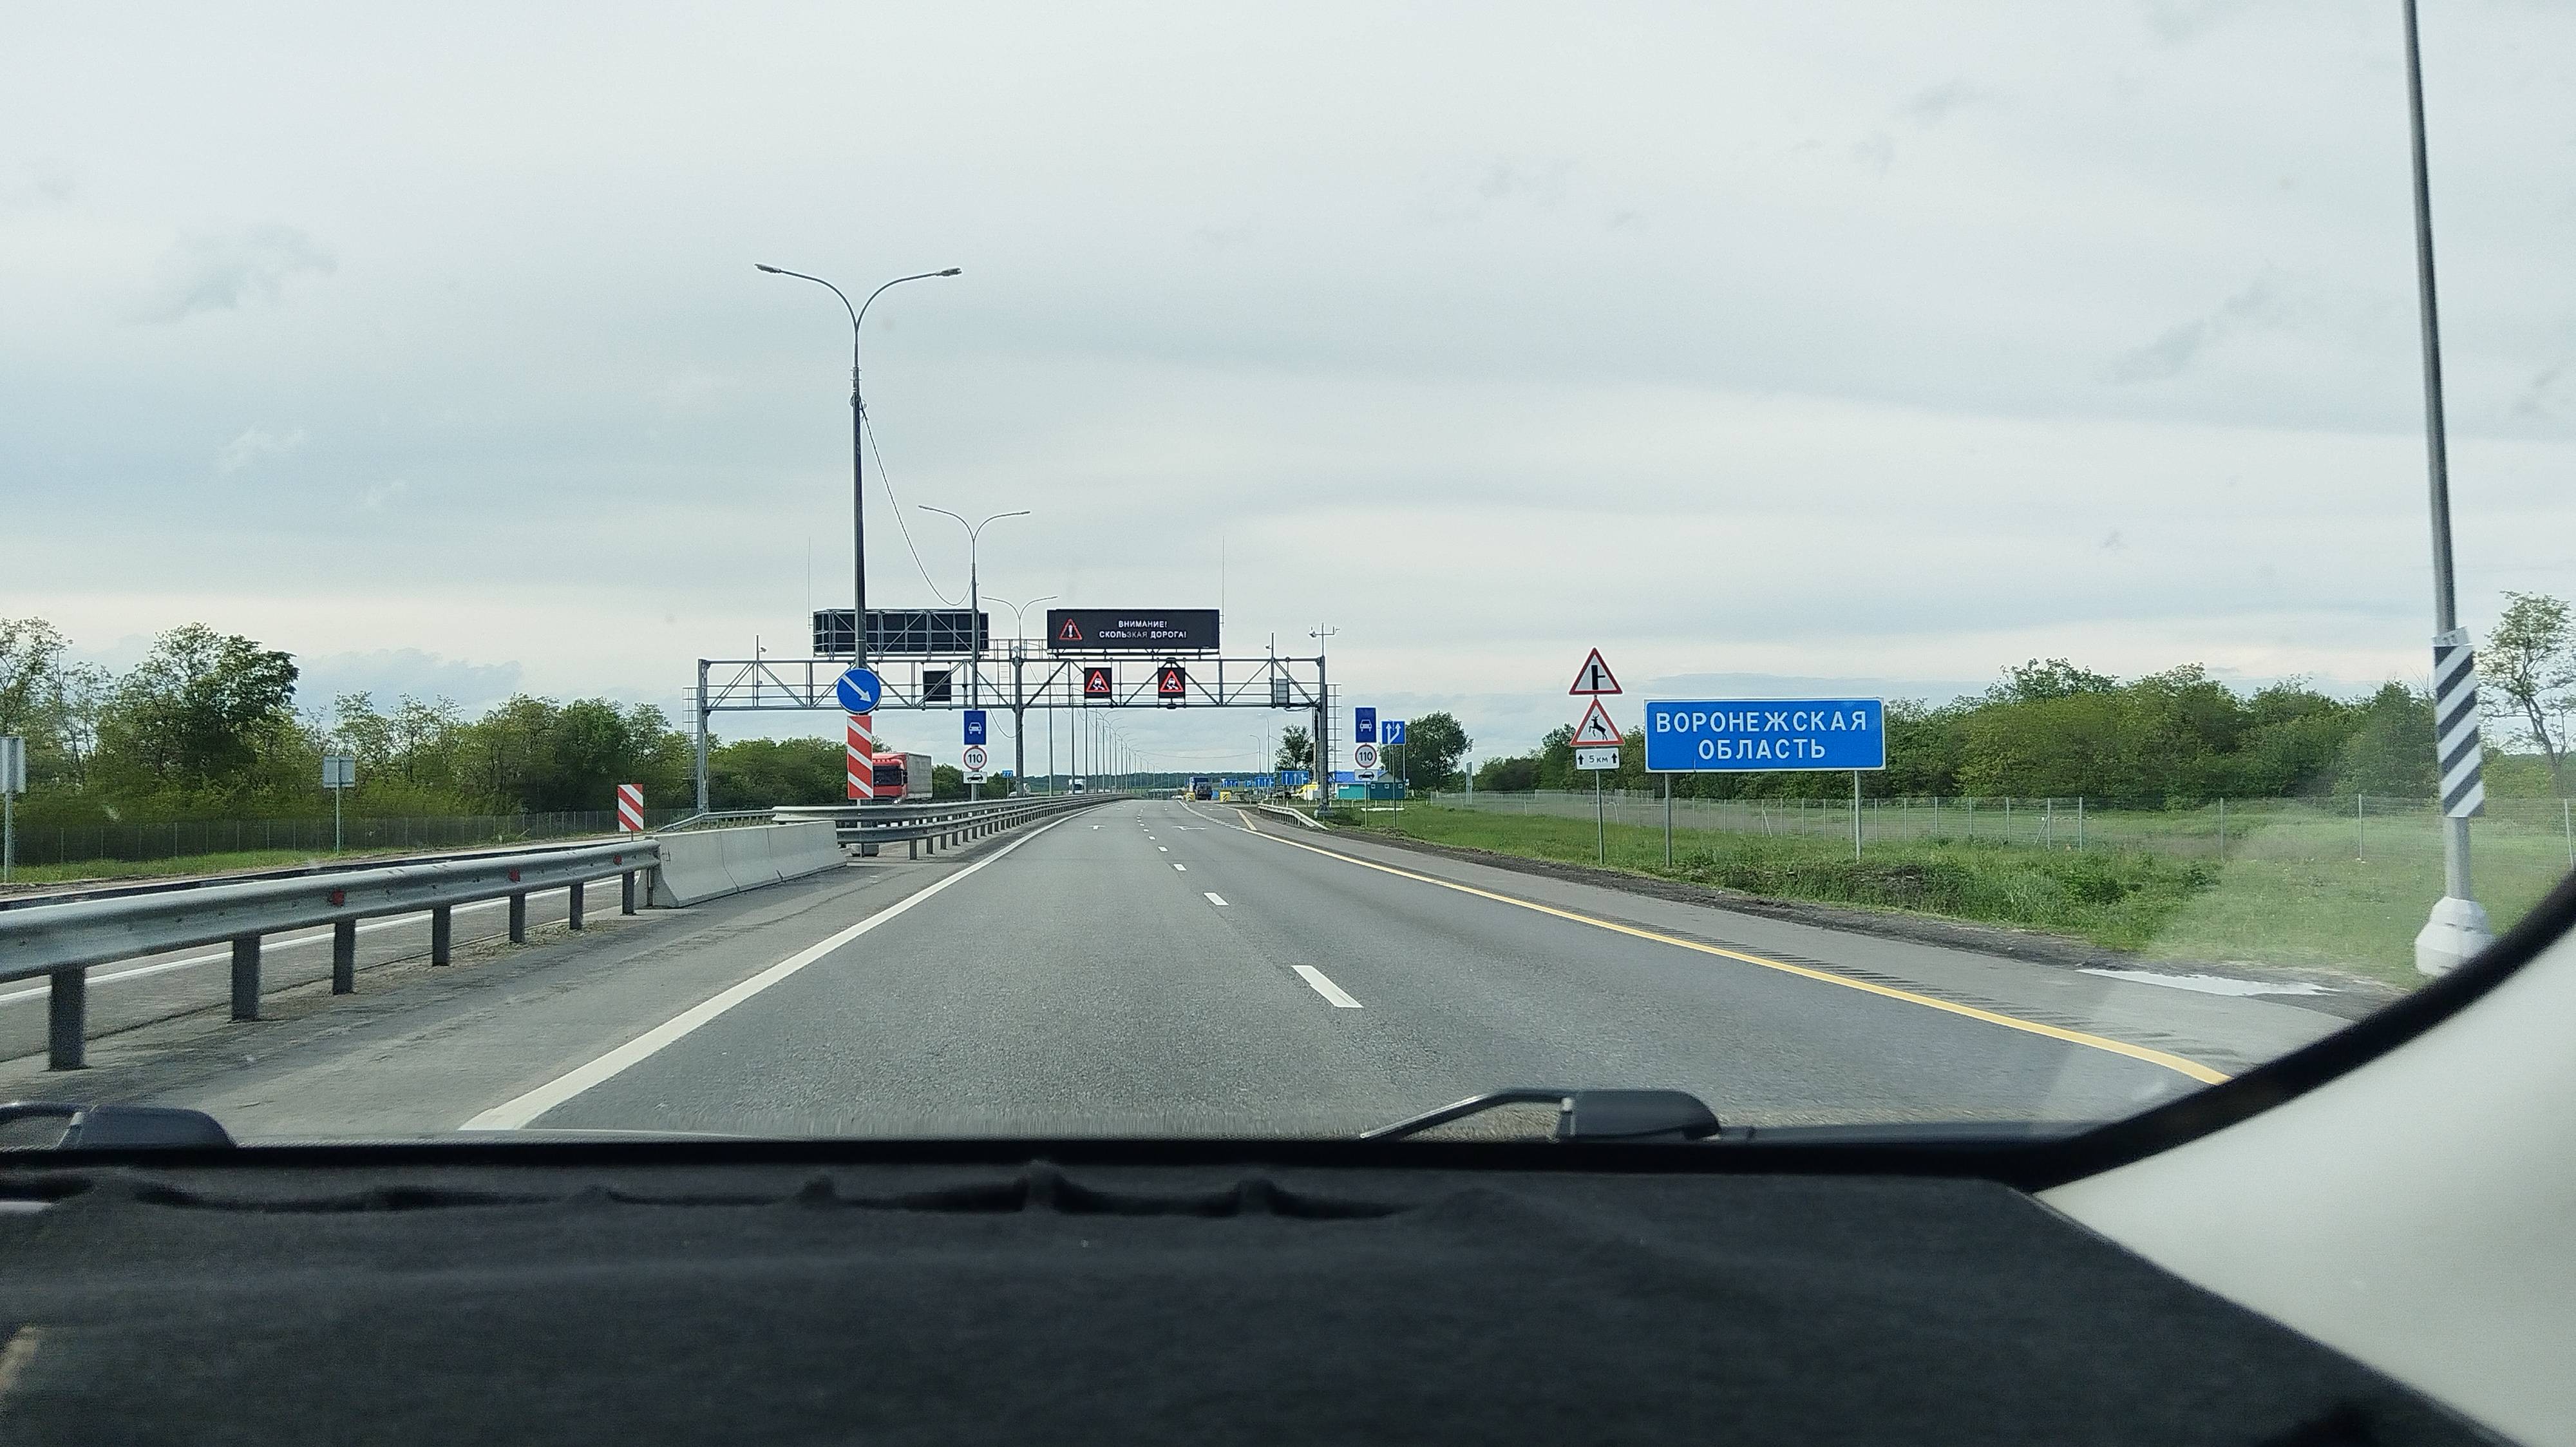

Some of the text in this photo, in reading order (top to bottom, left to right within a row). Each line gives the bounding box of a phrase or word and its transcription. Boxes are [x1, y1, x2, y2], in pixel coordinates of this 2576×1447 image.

[1656, 710, 1866, 733] ВОРОНЕЖСКАЯ
[1698, 739, 1826, 760] ОБЛАСТЬ
[968, 753, 983, 763] 110
[1359, 752, 1373, 761] 110
[1589, 755, 1595, 763] 5
